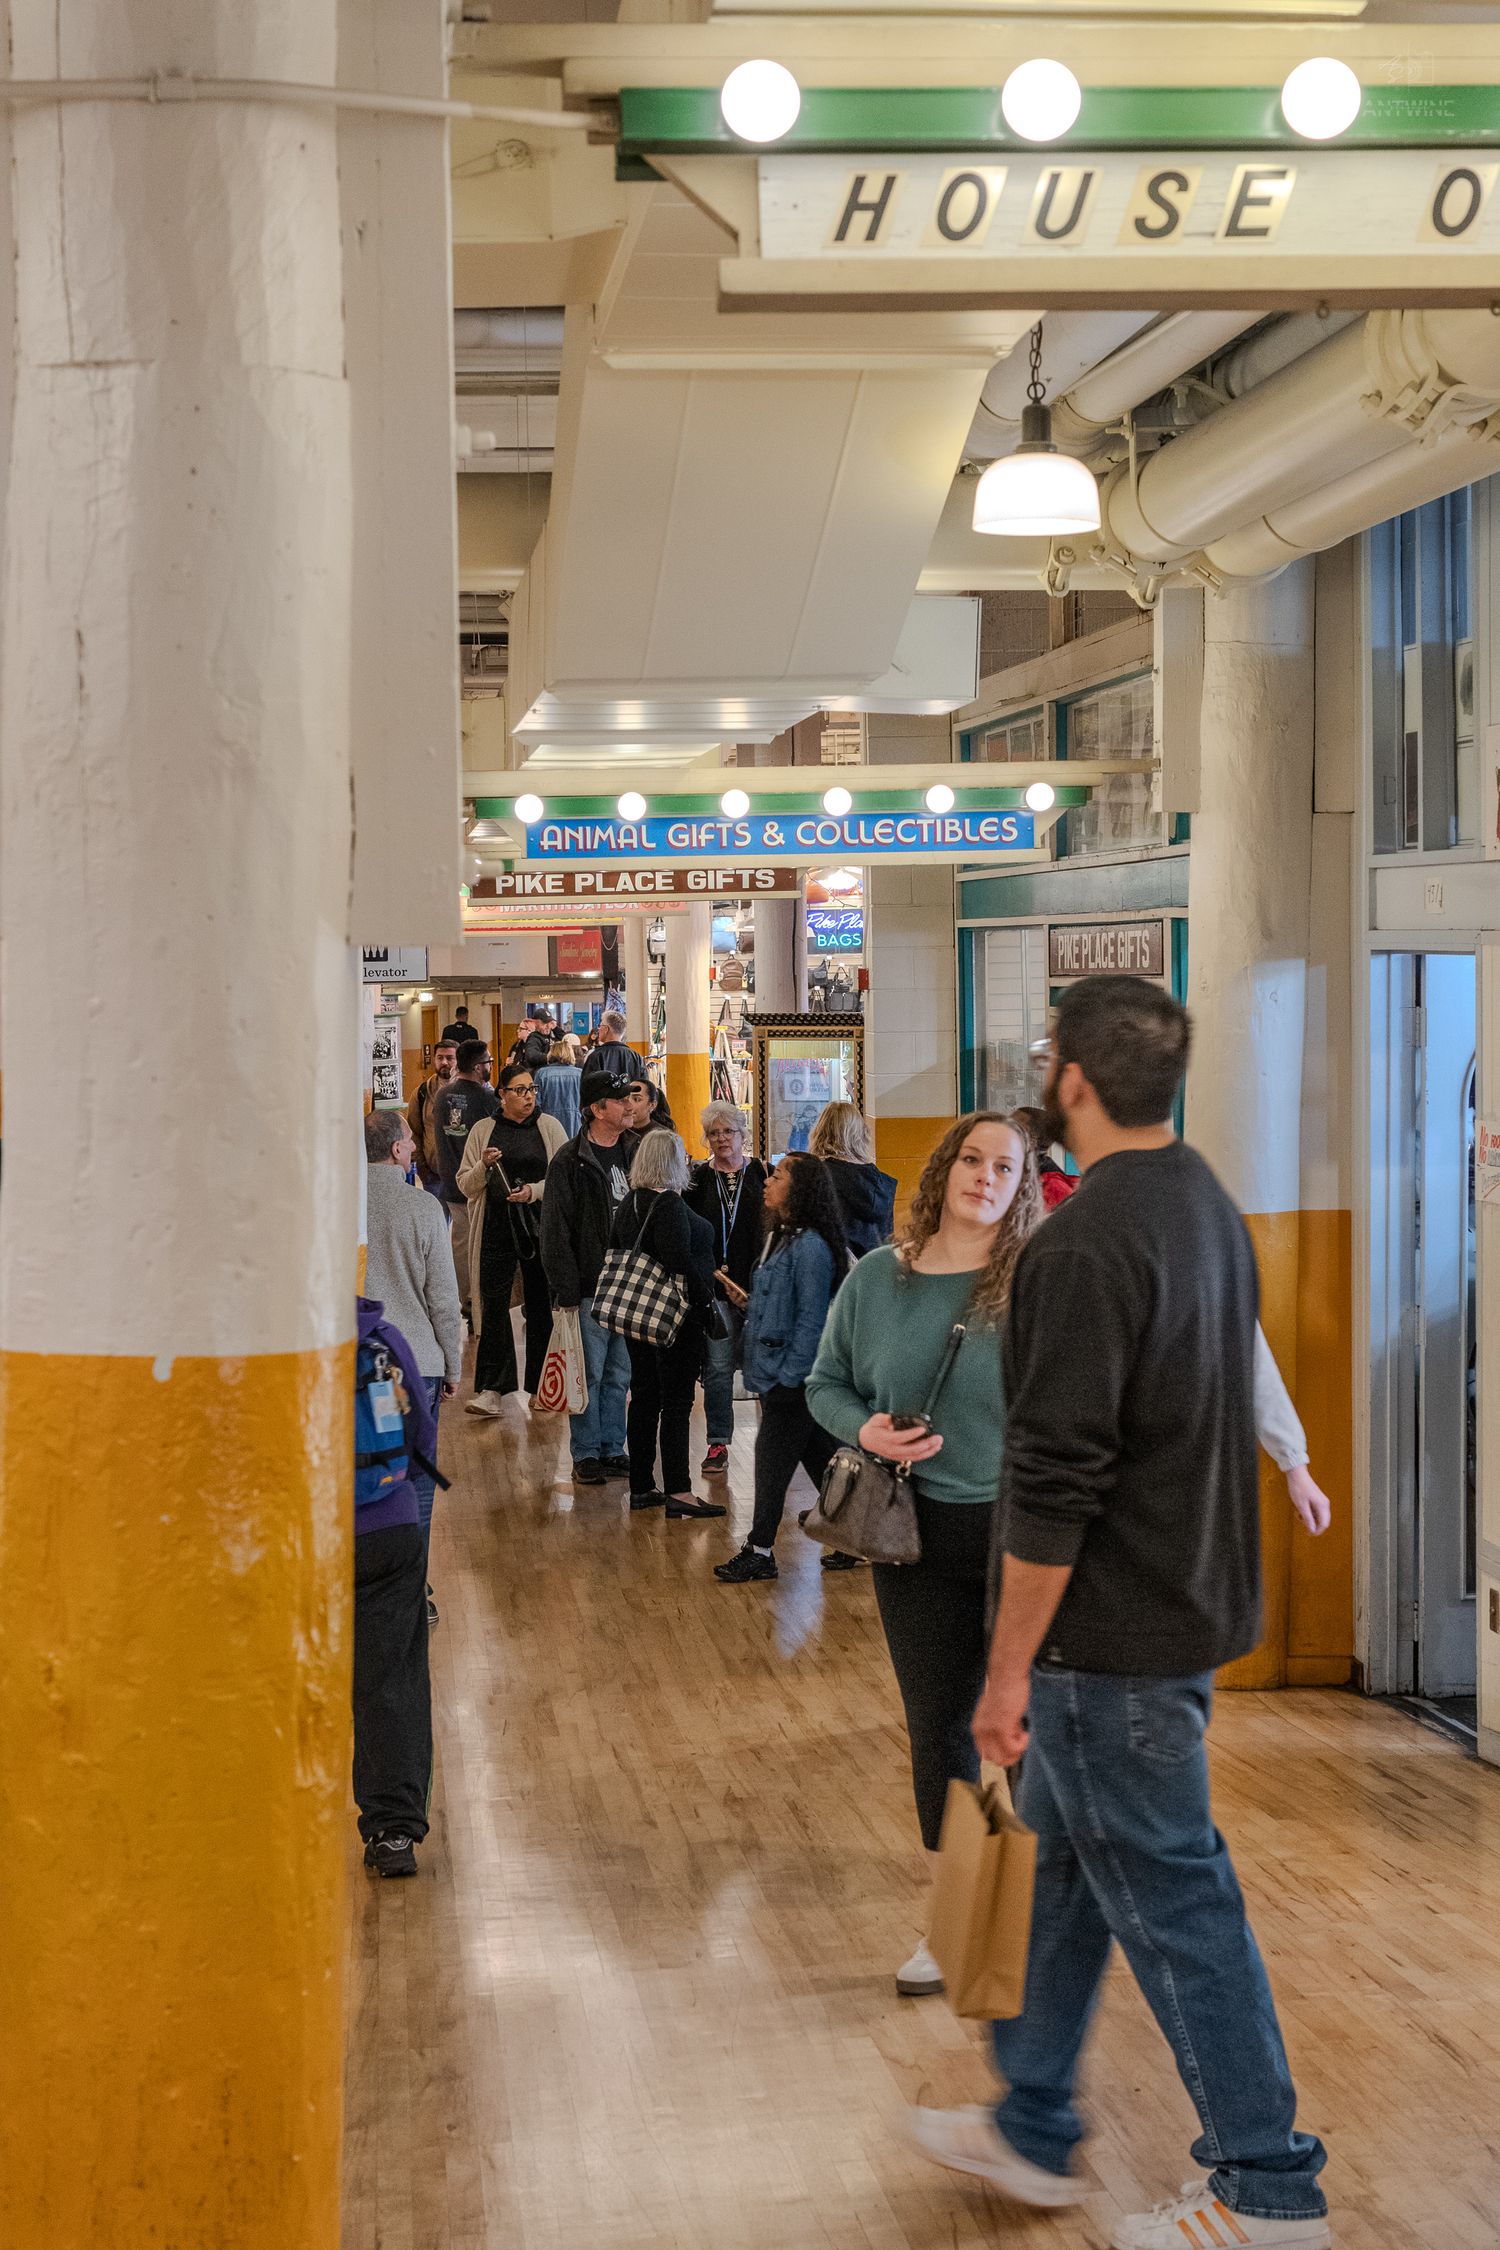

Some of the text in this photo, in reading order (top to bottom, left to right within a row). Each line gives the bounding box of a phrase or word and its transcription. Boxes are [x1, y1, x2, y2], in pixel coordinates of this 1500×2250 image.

[833, 167, 1483, 243] HOUSE O
[540, 817, 1019, 851] ANIMAL GIFTS & COLLECTIBLES
[495, 869, 776, 894] PIKE PLACE GIFTS
[806, 912, 864, 930] Pike Pla
[817, 933, 862, 947] BAGS
[1057, 929, 1150, 969] PIKE PLACE GIFTS
[363, 967, 408, 978] levator
